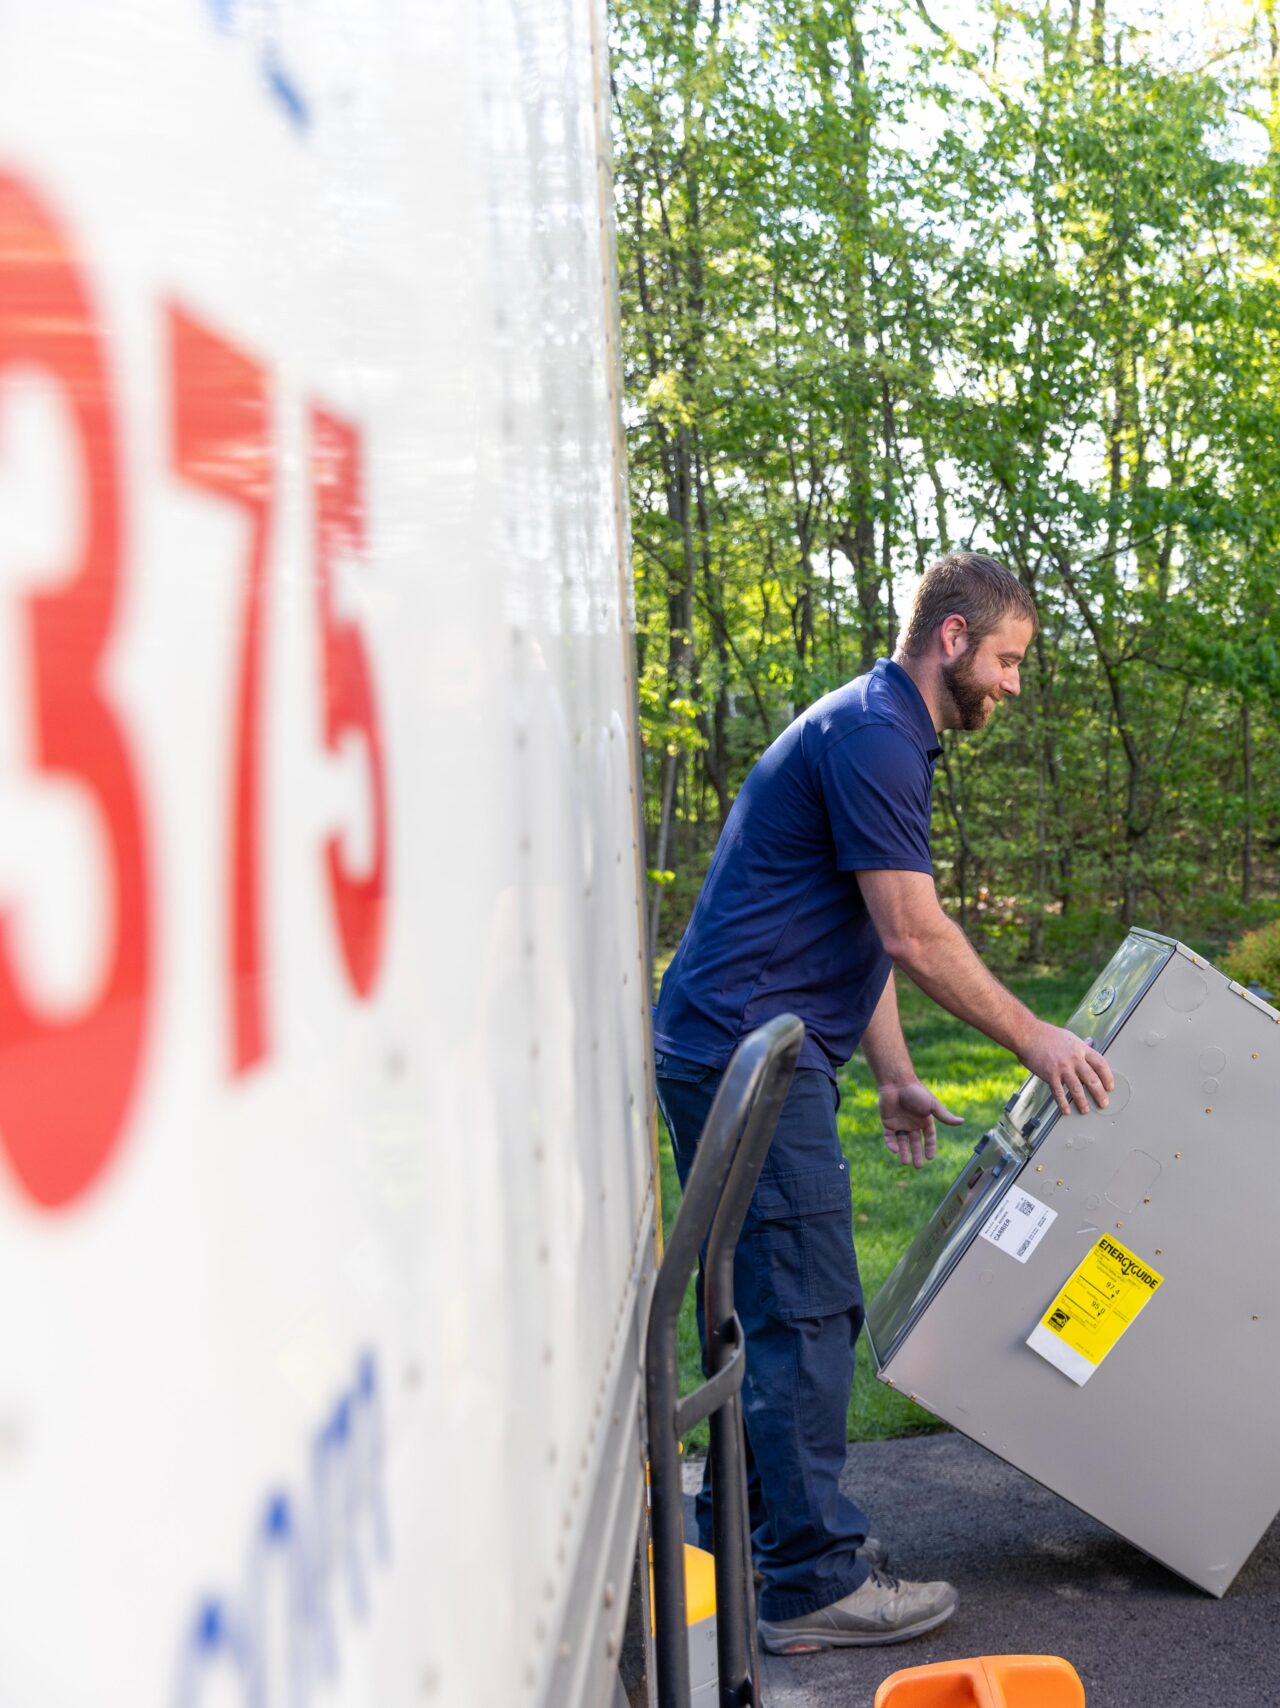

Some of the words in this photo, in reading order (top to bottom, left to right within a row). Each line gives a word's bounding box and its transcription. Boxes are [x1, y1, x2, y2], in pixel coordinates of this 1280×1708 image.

[0, 160, 392, 1214] 375
[993, 1218, 1011, 1241] CARRIER
[1098, 1239, 1159, 1289] ENERGYGUIDE
[1091, 1300, 1106, 1314] 950
